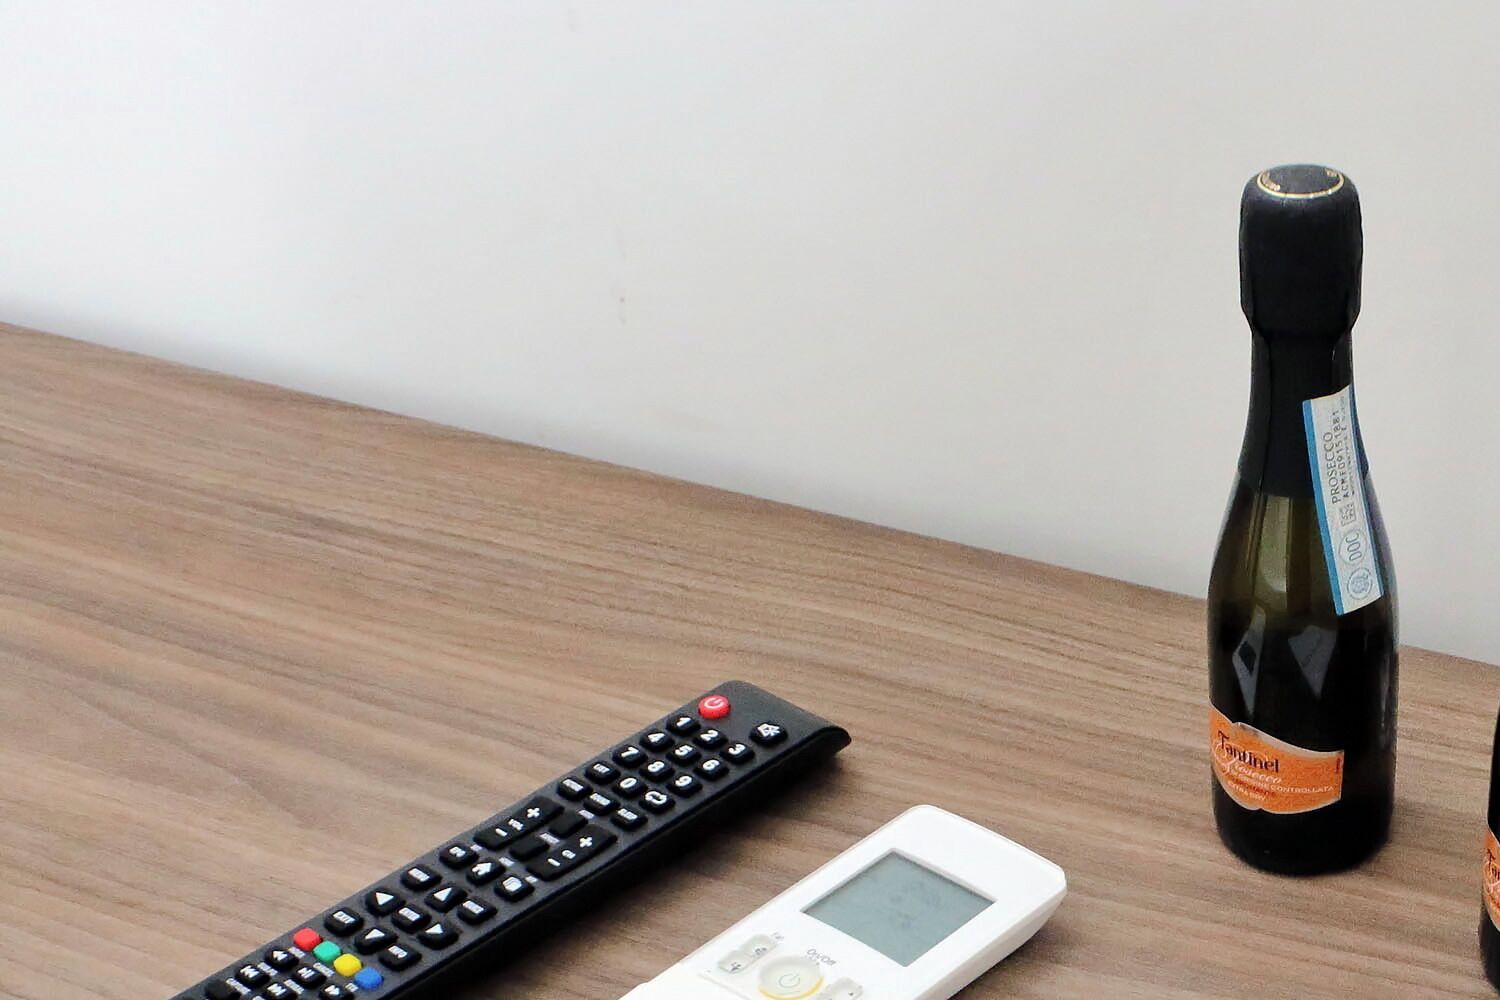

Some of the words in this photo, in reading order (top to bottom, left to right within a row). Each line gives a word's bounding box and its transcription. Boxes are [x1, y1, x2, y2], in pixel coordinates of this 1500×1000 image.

[1323, 431, 1341, 504] PROSECCO
[1346, 532, 1362, 562] DOC
[676, 717, 691, 727] 1
[647, 732, 665, 743] 4
[700, 729, 719, 742] 2
[621, 746, 639, 758] 7
[674, 744, 693, 756] 5
[728, 743, 746, 755] 3
[647, 761, 665, 773] 8
[702, 759, 720, 771] 6
[619, 777, 637, 789] 0
[675, 775, 693, 787] 9
